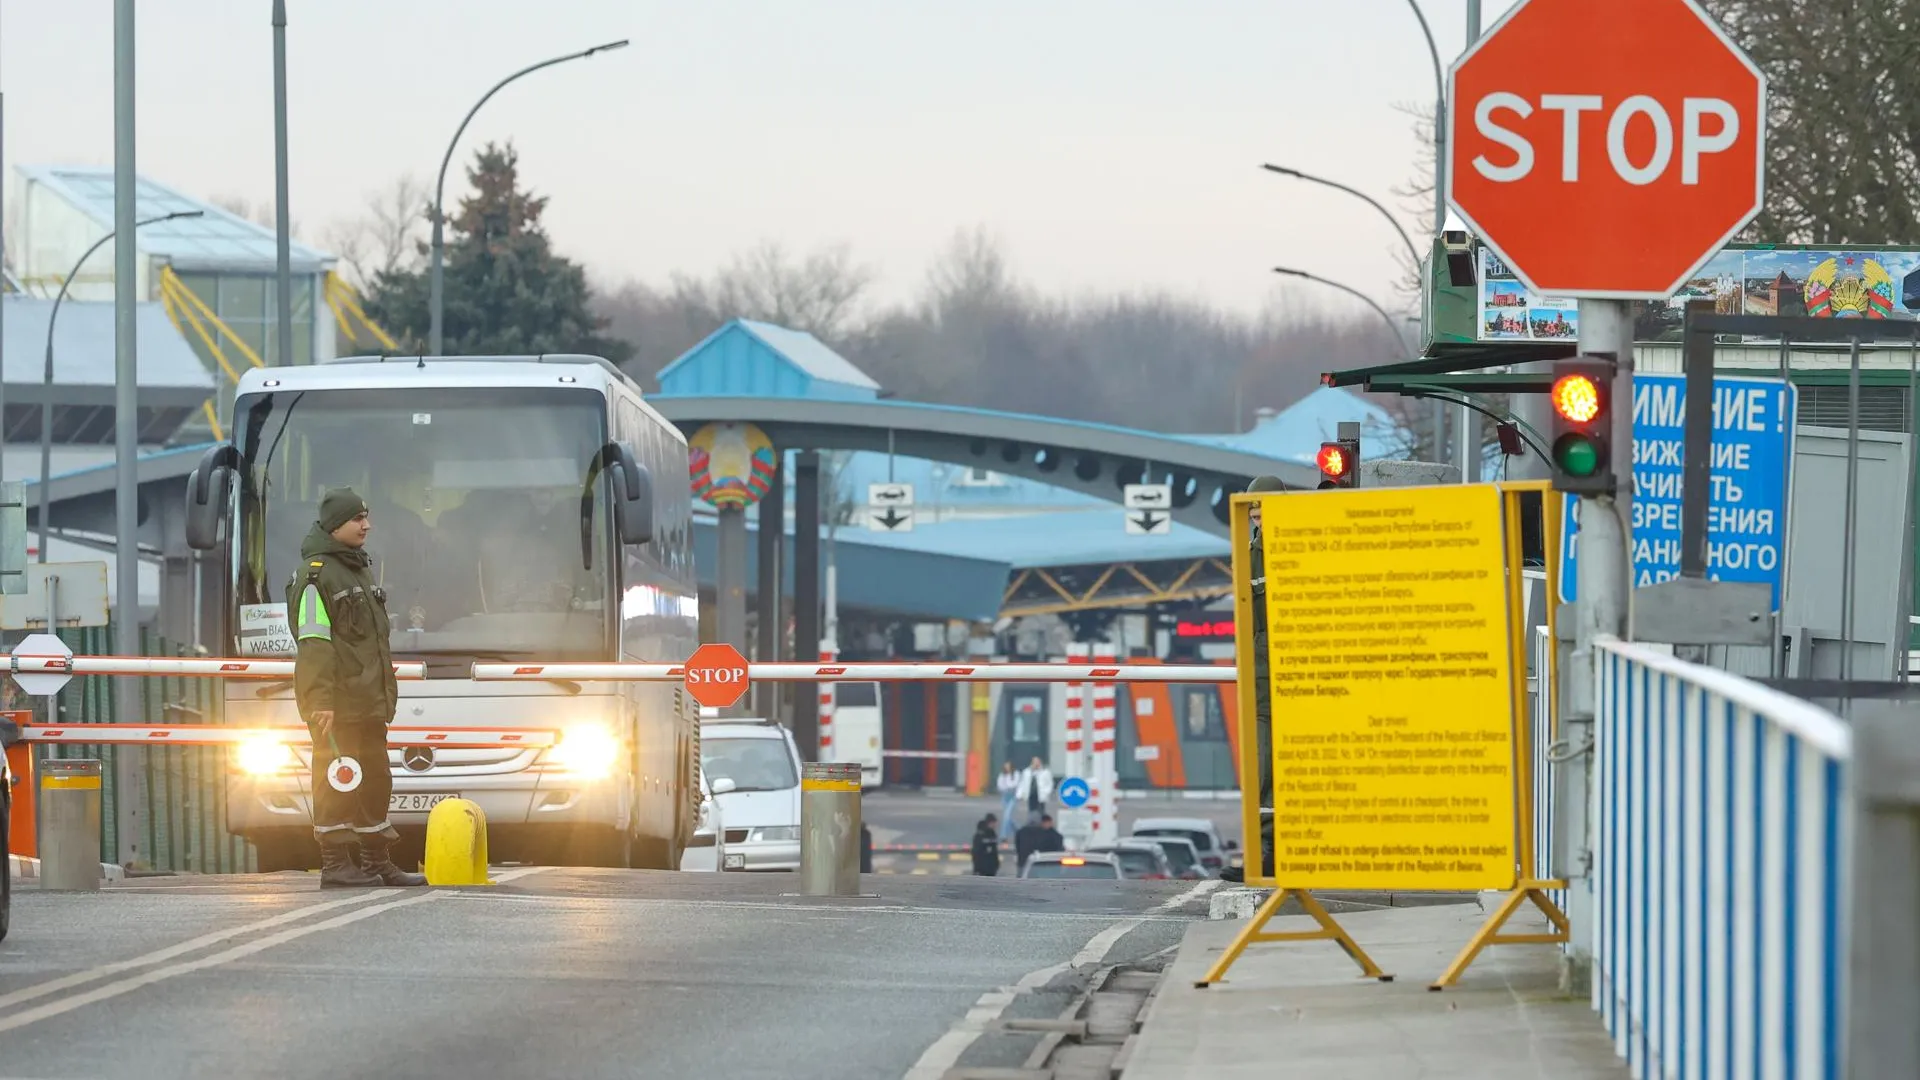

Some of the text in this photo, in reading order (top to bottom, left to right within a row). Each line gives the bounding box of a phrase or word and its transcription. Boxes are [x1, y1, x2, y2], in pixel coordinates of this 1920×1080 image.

[1472, 91, 1740, 186] STOP
[250, 639, 296, 654] WARSZA
[688, 668, 744, 683] STOP
